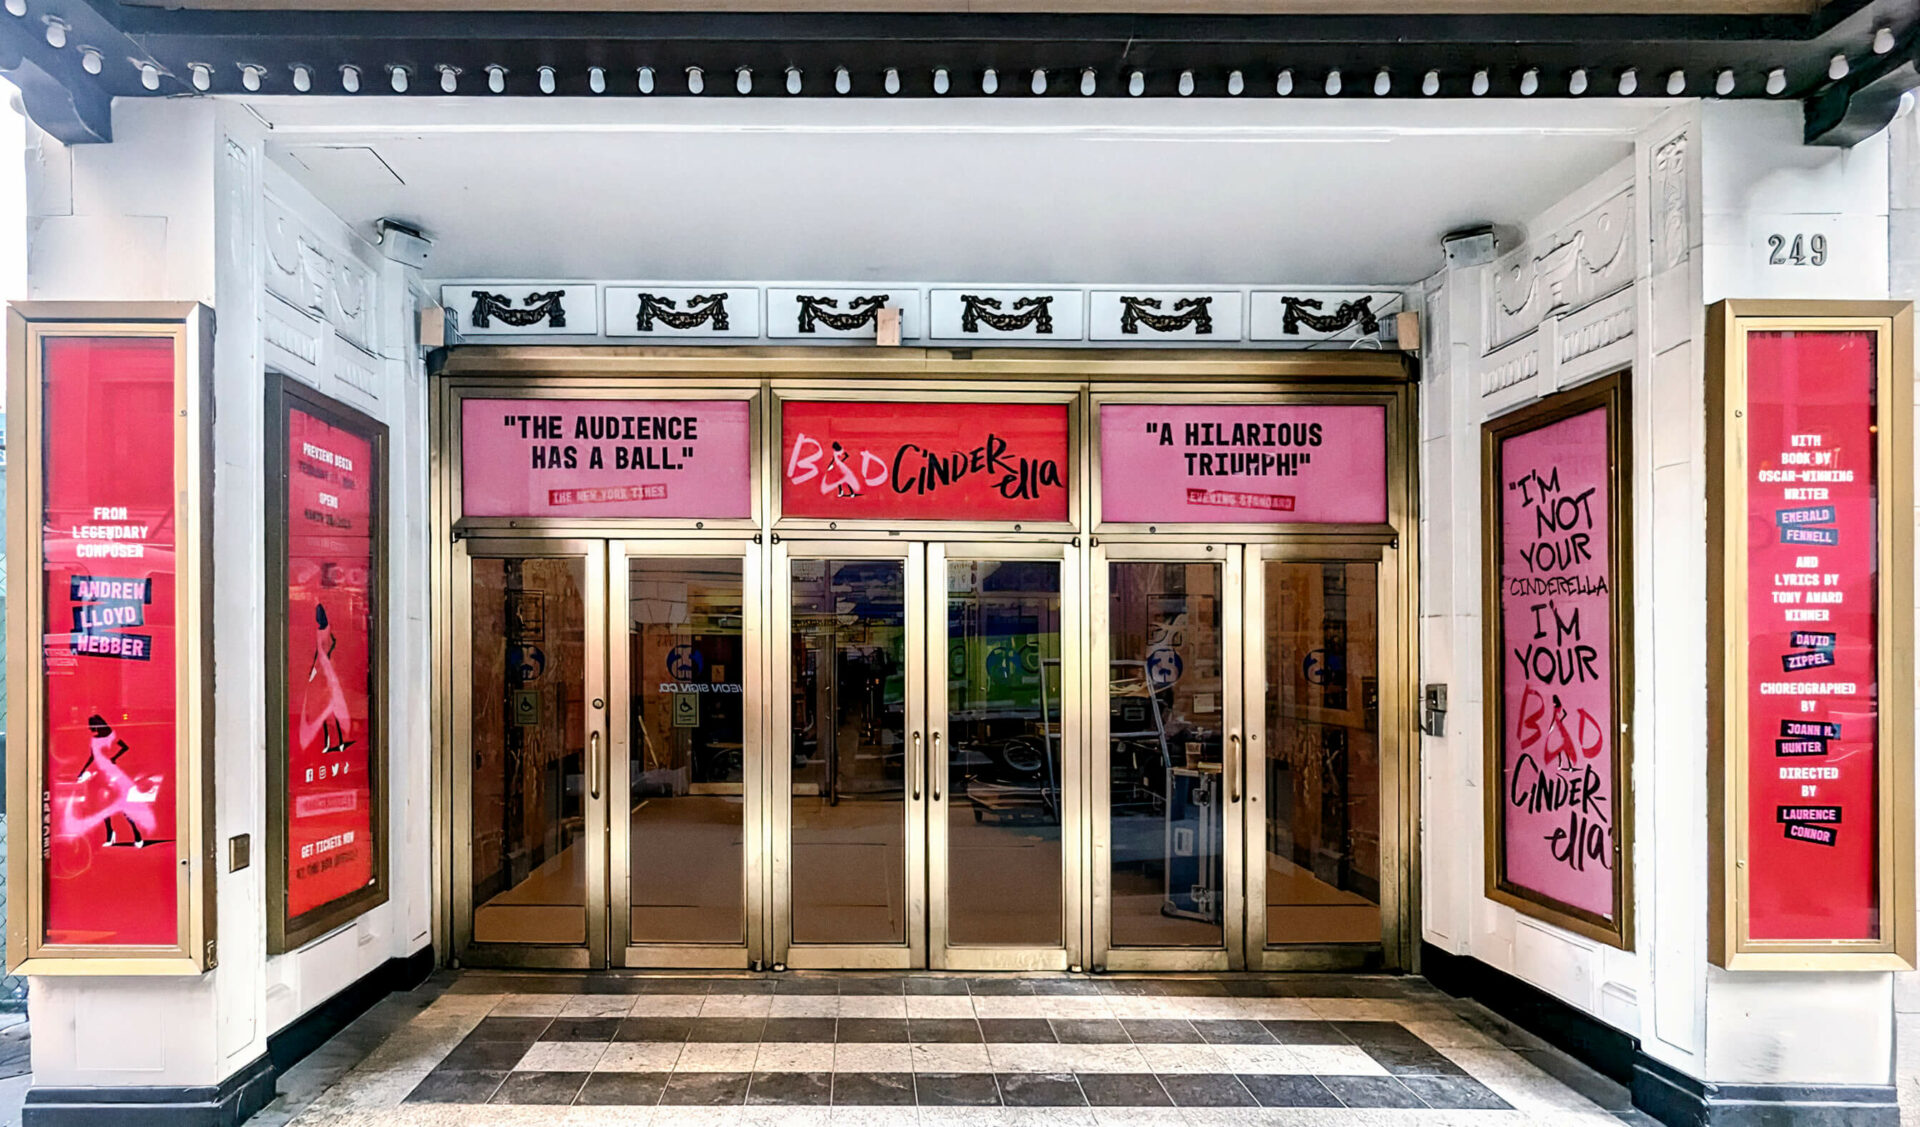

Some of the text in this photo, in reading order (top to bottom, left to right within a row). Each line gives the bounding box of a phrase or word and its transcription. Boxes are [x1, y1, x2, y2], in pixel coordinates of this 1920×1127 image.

[1767, 233, 1828, 267] 249
[504, 415, 698, 440] "THE AUDIENCE
[1146, 422, 1323, 447] "A HILARIOUS
[1791, 434, 1822, 447] WITH
[532, 445, 694, 470] HAS A BALL."
[1184, 452, 1311, 477] TRIUMPH!"
[1781, 452, 1832, 465] BOOK BY
[1758, 469, 1854, 482] OSCAR-WINNING
[552, 491, 573, 505] THE
[600, 487, 628, 501] YORK
[1783, 488, 1829, 500] WRITER
[93, 506, 128, 521] FROM
[1536, 487, 1596, 539] NOT
[1781, 508, 1830, 524] EMERALD
[72, 525, 149, 540] LEGENDARY
[1786, 529, 1832, 543] FENNELL
[76, 543, 145, 558] COMPOSER
[1519, 532, 1592, 573] YOUR
[1795, 556, 1819, 568] AND
[1510, 575, 1609, 597] CINDERELLA
[1774, 573, 1840, 586] LYRICS BY
[77, 580, 146, 600] ANDREW
[1771, 591, 1843, 604] TONY AWARD
[80, 605, 137, 628] LLOYD
[1785, 609, 1830, 621] WINNER
[1530, 599, 1581, 647] I'M
[77, 635, 145, 657] WEBBER
[1796, 634, 1830, 646] DAVID
[1514, 643, 1599, 686] YOUR
[1788, 652, 1831, 669] ZIPPEL
[1760, 682, 1856, 695] CHOREOGRAPHED
[1800, 700, 1817, 712] BY
[1787, 723, 1821, 736] JOANN
[1781, 741, 1822, 754] HUNTER
[1779, 767, 1839, 780] DIRECTED
[1801, 784, 1817, 797] BY
[1782, 808, 1836, 821] LAURENCE
[1790, 825, 1831, 843] CONNOR
